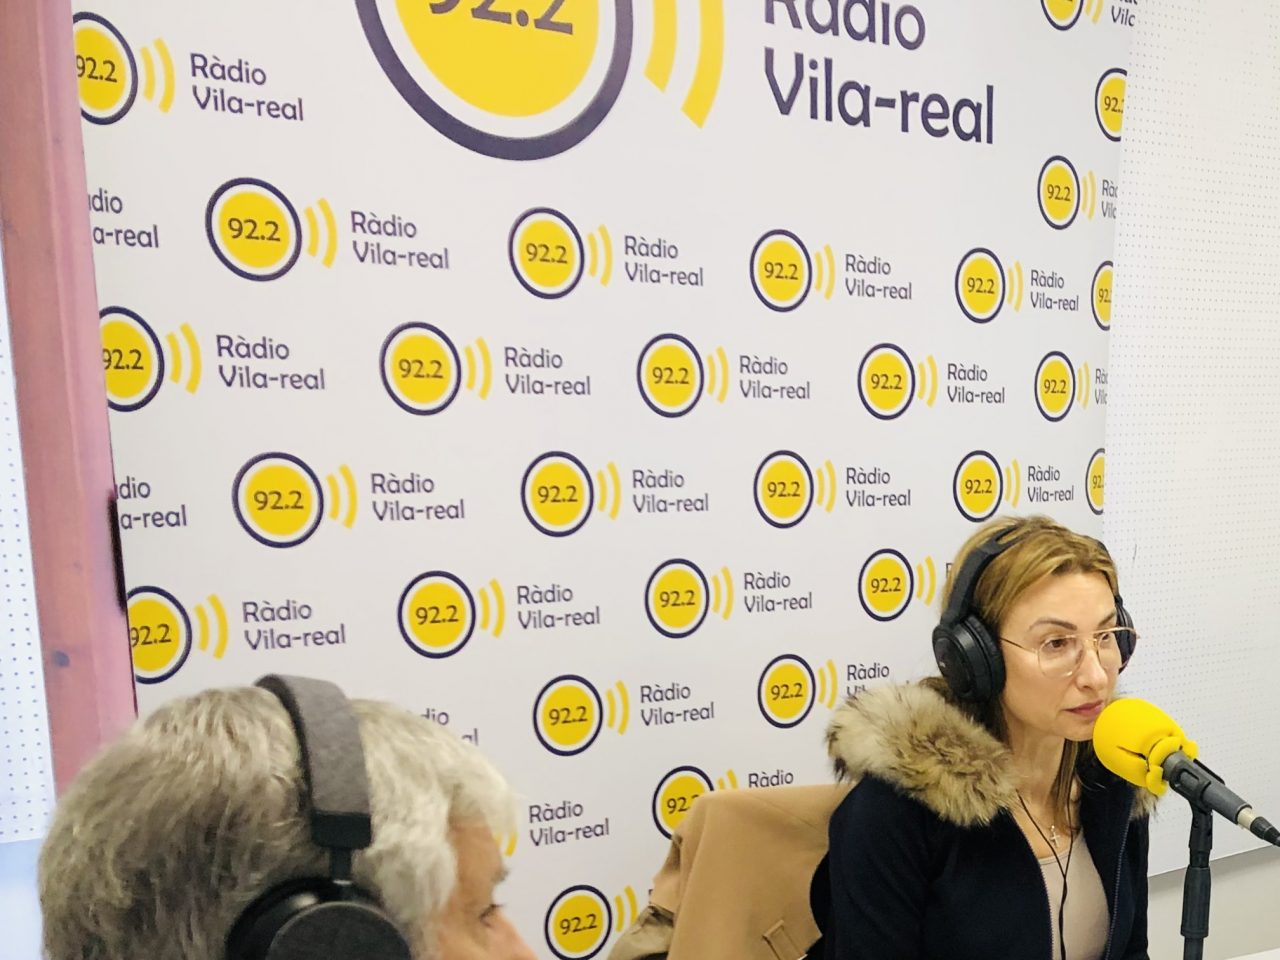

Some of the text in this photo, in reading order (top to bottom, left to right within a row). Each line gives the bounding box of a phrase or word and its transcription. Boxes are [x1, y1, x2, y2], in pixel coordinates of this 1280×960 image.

[190, 53, 266, 85] Ràdio
[192, 85, 303, 121] Vila-real
[765, 47, 994, 144] Vila-real
[1048, 184, 1070, 201] 92.2
[228, 218, 280, 241] 92.2
[351, 211, 416, 238] Ràdio
[93, 224, 159, 248] a-real
[353, 240, 449, 269] Vila-real
[527, 243, 567, 264] 92.2
[625, 235, 678, 259] Ràdio
[625, 262, 703, 286] Vila-real
[765, 262, 798, 280] 92.2
[846, 254, 891, 275] Ràdio
[845, 278, 911, 299] Vila-real
[967, 277, 994, 294] 92.2
[1031, 270, 1064, 288] Ràdio
[1031, 292, 1079, 311] Vila-real
[216, 335, 289, 360] Ràdio
[505, 347, 562, 368] Ràdio
[399, 359, 443, 378] 92.2
[740, 355, 788, 375] Ràdio
[948, 363, 987, 381] Ràdio
[219, 365, 325, 390] Vila-real
[506, 374, 590, 395] Vila-real
[653, 367, 689, 384] 92.2
[871, 374, 902, 389] 92.2
[740, 380, 809, 399] Vila-real
[947, 386, 1004, 403] Vila-real
[1044, 379, 1066, 393] 92.2
[371, 473, 434, 494] Ràdio
[633, 470, 684, 488] Ràdio
[847, 467, 890, 484] Ràdio
[1028, 466, 1060, 481] Ràdio
[538, 485, 577, 503] 92.2
[768, 481, 800, 497] 92.2
[965, 479, 992, 494] 92.2
[1028, 486, 1074, 502] Vila-real
[254, 491, 304, 510] 92.2
[633, 493, 708, 513] Vila-real
[846, 489, 910, 507] Vila-real
[121, 504, 187, 530] a-real
[372, 499, 464, 521] Vila-real
[744, 571, 790, 590] Ràdio
[871, 577, 901, 593] 92.2
[517, 584, 573, 604] Ràdio
[660, 590, 695, 607] 92.2
[744, 592, 812, 613] Vila-real
[243, 600, 312, 622] Ràdio
[416, 605, 459, 625] 92.2
[518, 606, 600, 629] Vila-real
[244, 624, 345, 650] Vila-real
[847, 663, 889, 681] Ràdio
[640, 683, 690, 703] Ràdio
[771, 683, 803, 700] 92.2
[549, 706, 587, 725] 92.2
[641, 702, 714, 726] Vila-real
[749, 770, 793, 788] Ràdio
[529, 801, 583, 823] Ràdio
[530, 818, 609, 846] Vila-real
[560, 912, 598, 935] 92.2
